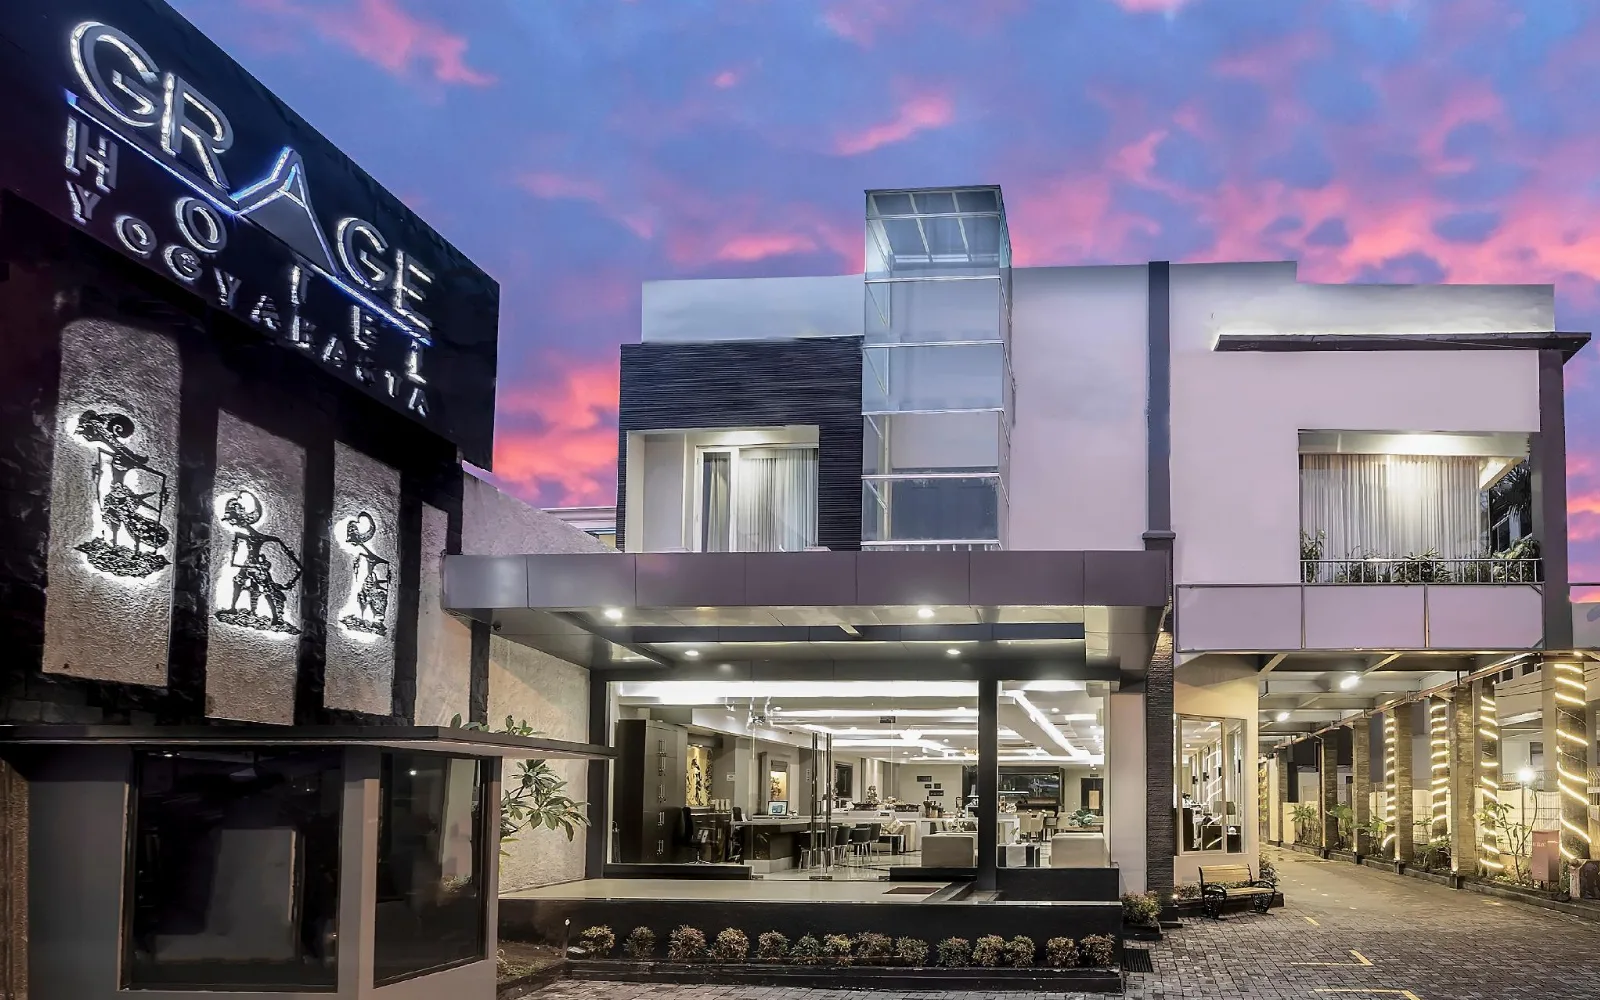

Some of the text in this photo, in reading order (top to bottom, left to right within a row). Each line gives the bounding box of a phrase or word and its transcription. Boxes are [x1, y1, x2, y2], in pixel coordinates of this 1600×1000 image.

[65, 114, 428, 385] HOTEL
[65, 179, 430, 418] YOGYAKARTA
[69, 21, 434, 333] GRAGE
